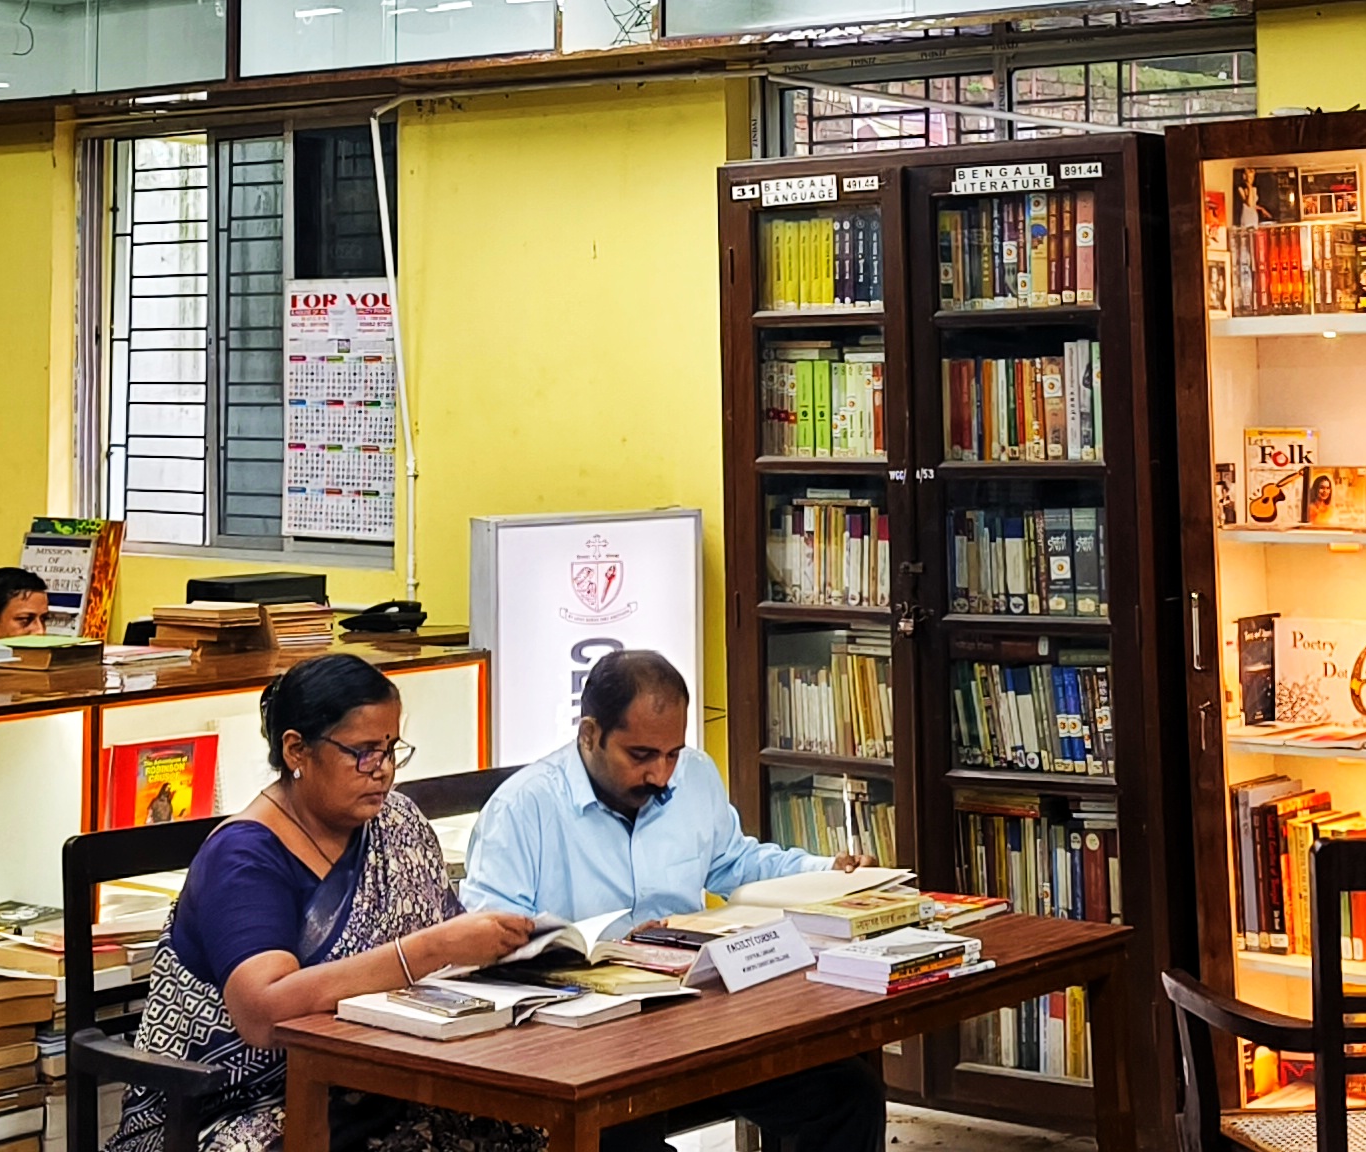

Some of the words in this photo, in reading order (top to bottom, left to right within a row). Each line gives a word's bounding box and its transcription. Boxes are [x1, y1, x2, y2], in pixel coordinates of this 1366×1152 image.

[957, 166, 1045, 180] BENGALI
[1064, 165, 1099, 176] 891.44
[764, 178, 834, 192] BENGALI
[846, 179, 876, 189] 491.44
[954, 177, 1052, 192] LITERATURE
[736, 186, 757, 197] 31
[765, 189, 834, 204] LANGUAGE
[291, 294, 337, 308] FOR
[1248, 437, 1272, 446] Let's
[1259, 444, 1314, 467] Folk
[889, 470, 907, 485] WCC/
[44, 566, 83, 574] LIBRARY
[1292, 631, 1337, 657] Poetry
[1323, 662, 1348, 679] Dot
[145, 763, 185, 775] ROBINSON
[148, 772, 179, 783] CRUSOE
[727, 936, 755, 954] FACULTY
[755, 930, 780, 945] CORNER
